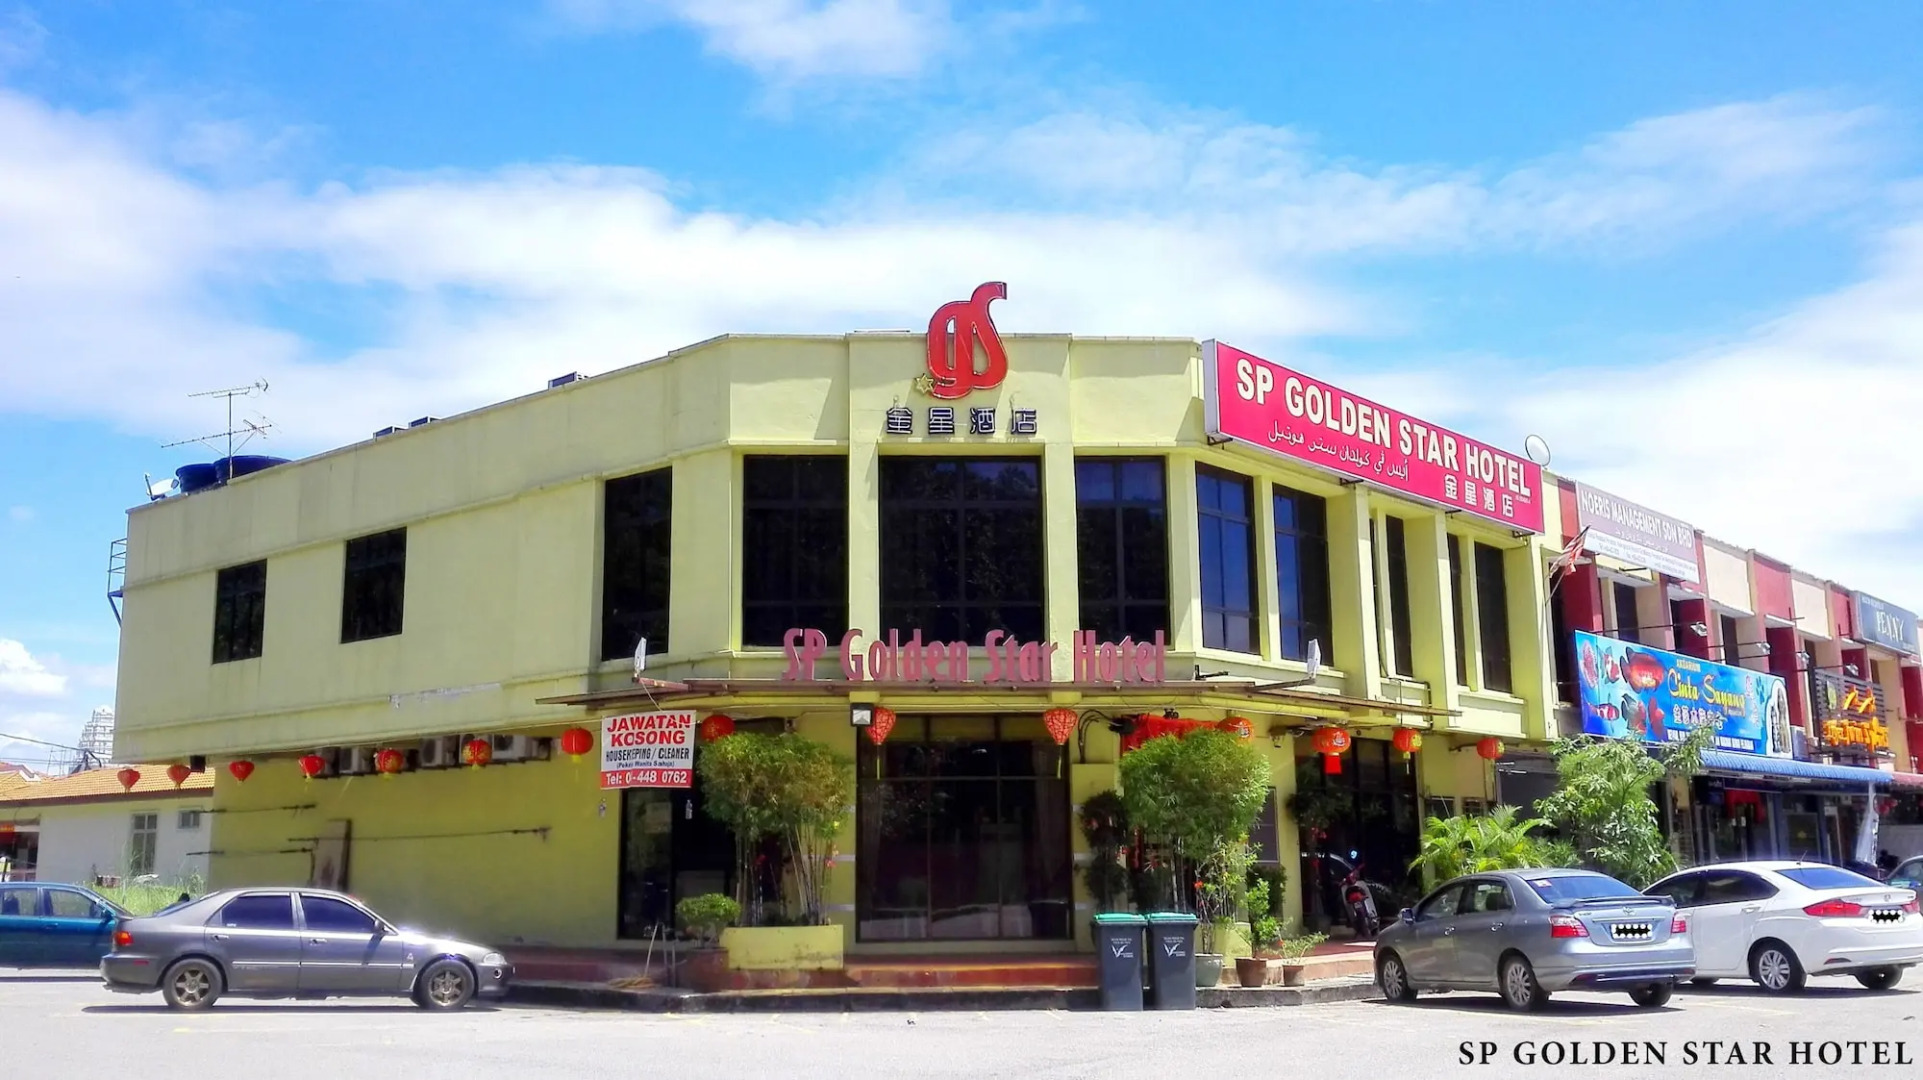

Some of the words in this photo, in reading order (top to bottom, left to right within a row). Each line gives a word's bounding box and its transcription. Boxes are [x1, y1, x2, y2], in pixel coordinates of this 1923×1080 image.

[886, 407, 1037, 434] 金星酒店
[1236, 358, 1274, 405] SP
[1284, 376, 1391, 449] GOLDEN
[1397, 418, 1460, 472] STAR
[1464, 442, 1531, 497] HOTEL
[1444, 473, 1514, 518] 金星酒店
[1611, 502, 1662, 538] MANAGEMENT
[782, 628, 828, 681] SP
[840, 628, 969, 682] Golden
[984, 629, 1058, 683] Star
[1073, 629, 1165, 683] Hotel
[1668, 668, 1700, 701] Cinta
[1701, 674, 1746, 710] Sayang
[607, 714, 691, 733] JAWATAN
[658, 748, 690, 760] CLEANER
[606, 773, 622, 785] Tel:
[661, 771, 687, 783] 0762
